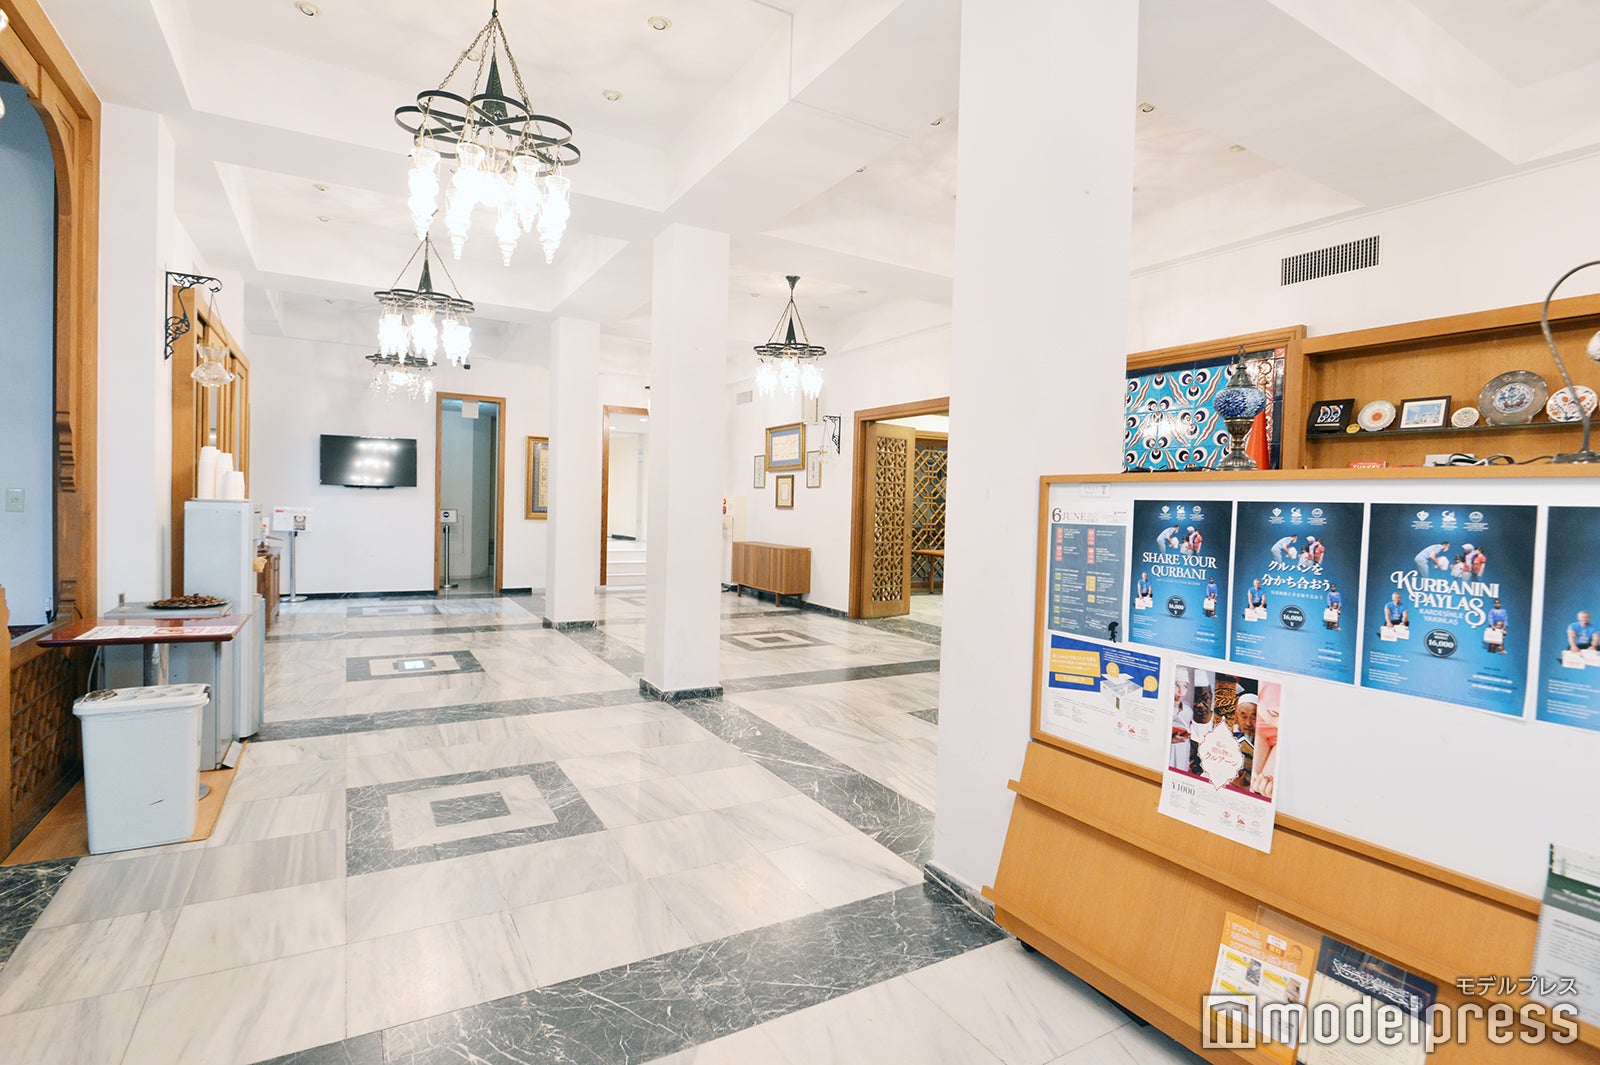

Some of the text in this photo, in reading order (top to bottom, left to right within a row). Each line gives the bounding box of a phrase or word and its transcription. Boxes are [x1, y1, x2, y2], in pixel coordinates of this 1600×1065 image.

[1052, 507, 1062, 523] 6
[1063, 511, 1087, 521] JUNE
[1142, 552, 1217, 569] SHARE YOUR
[1268, 560, 1324, 576] クルバンを
[1151, 565, 1207, 580] QURBANI
[1261, 574, 1331, 592] 分かち合おう
[1390, 570, 1500, 599] KURBANINI
[1283, 614, 1303, 622] 16,000
[1408, 591, 1487, 629] PAYLAŞ
[1428, 639, 1454, 649] 16,000
[1205, 751, 1239, 767] クルアーン
